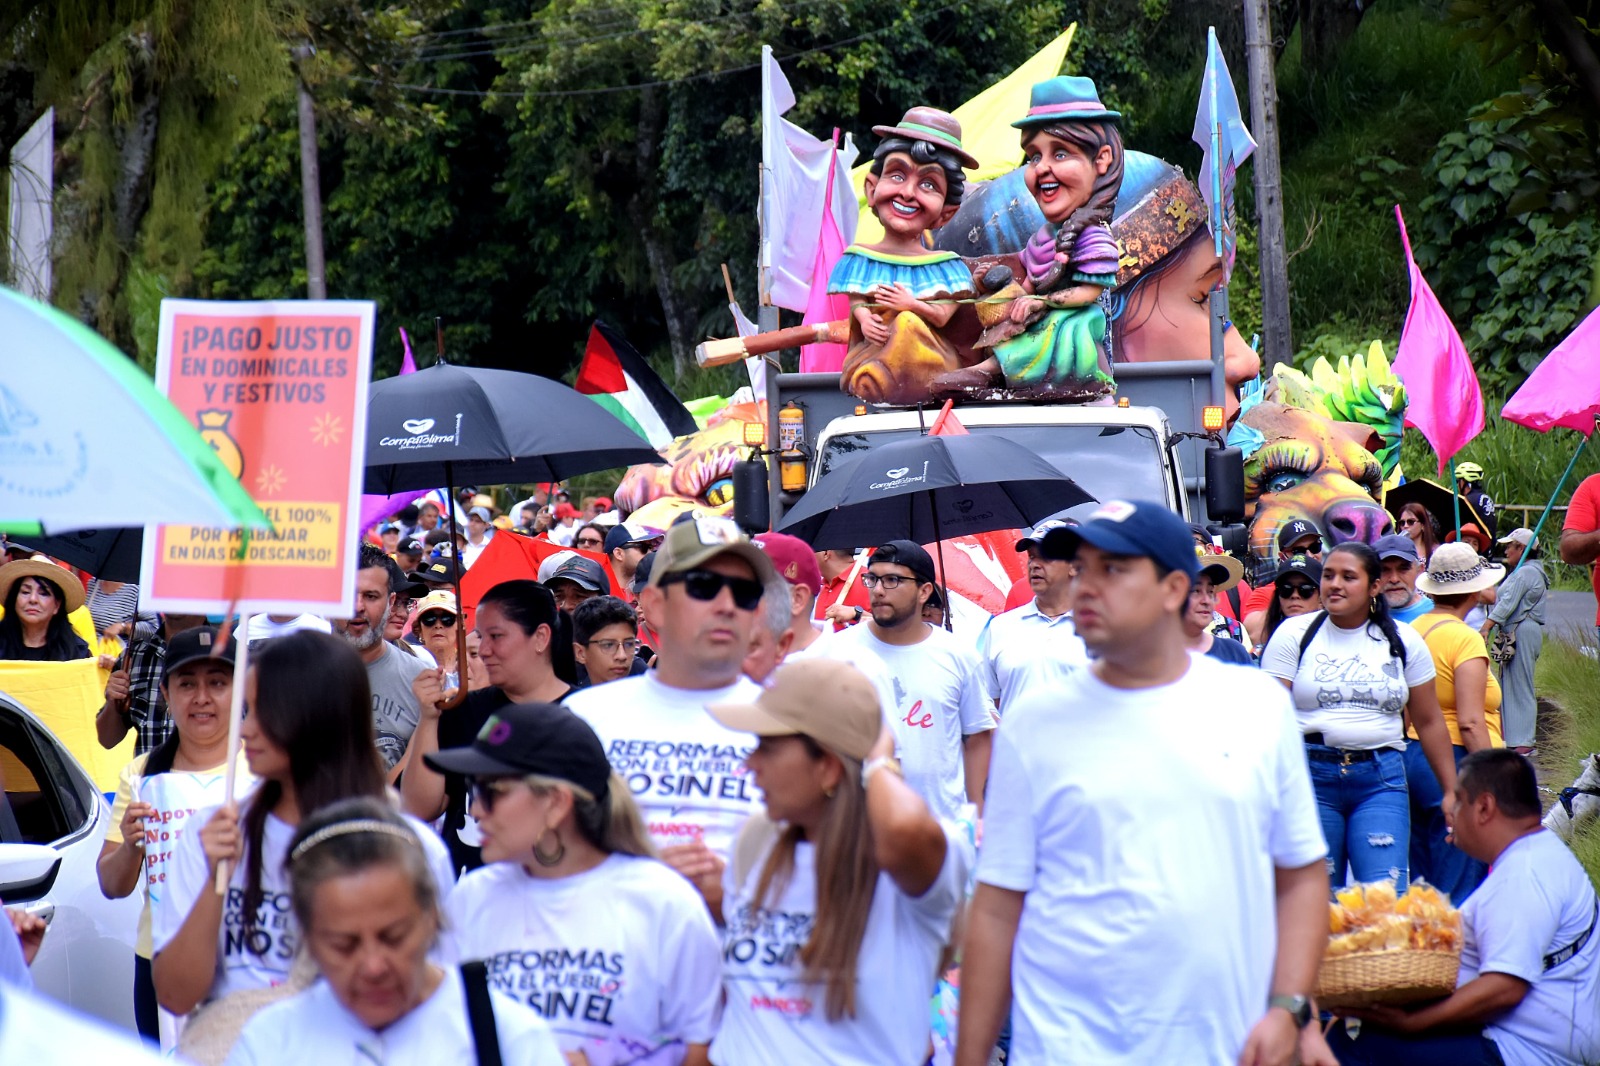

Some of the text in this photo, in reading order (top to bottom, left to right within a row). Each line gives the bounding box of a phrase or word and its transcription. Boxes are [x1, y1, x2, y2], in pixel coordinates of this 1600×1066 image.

[182, 326, 353, 353] ¡PAGO JUSTO
[181, 357, 348, 378] EN DOMINICALES
[204, 383, 326, 404] Y FESTIVOS
[288, 508, 332, 523] 100%
[190, 527, 221, 542] POR
[169, 545, 188, 560] EN
[192, 545, 225, 560] DÍAS
[250, 546, 332, 562] DESCANSO!
[653, 759, 670, 772] EL
[656, 775, 713, 797] SIN
[719, 777, 751, 802] EL
[145, 828, 170, 844] No
[225, 929, 272, 957] NO
[519, 974, 537, 990] EL
[582, 994, 613, 1026] EL
